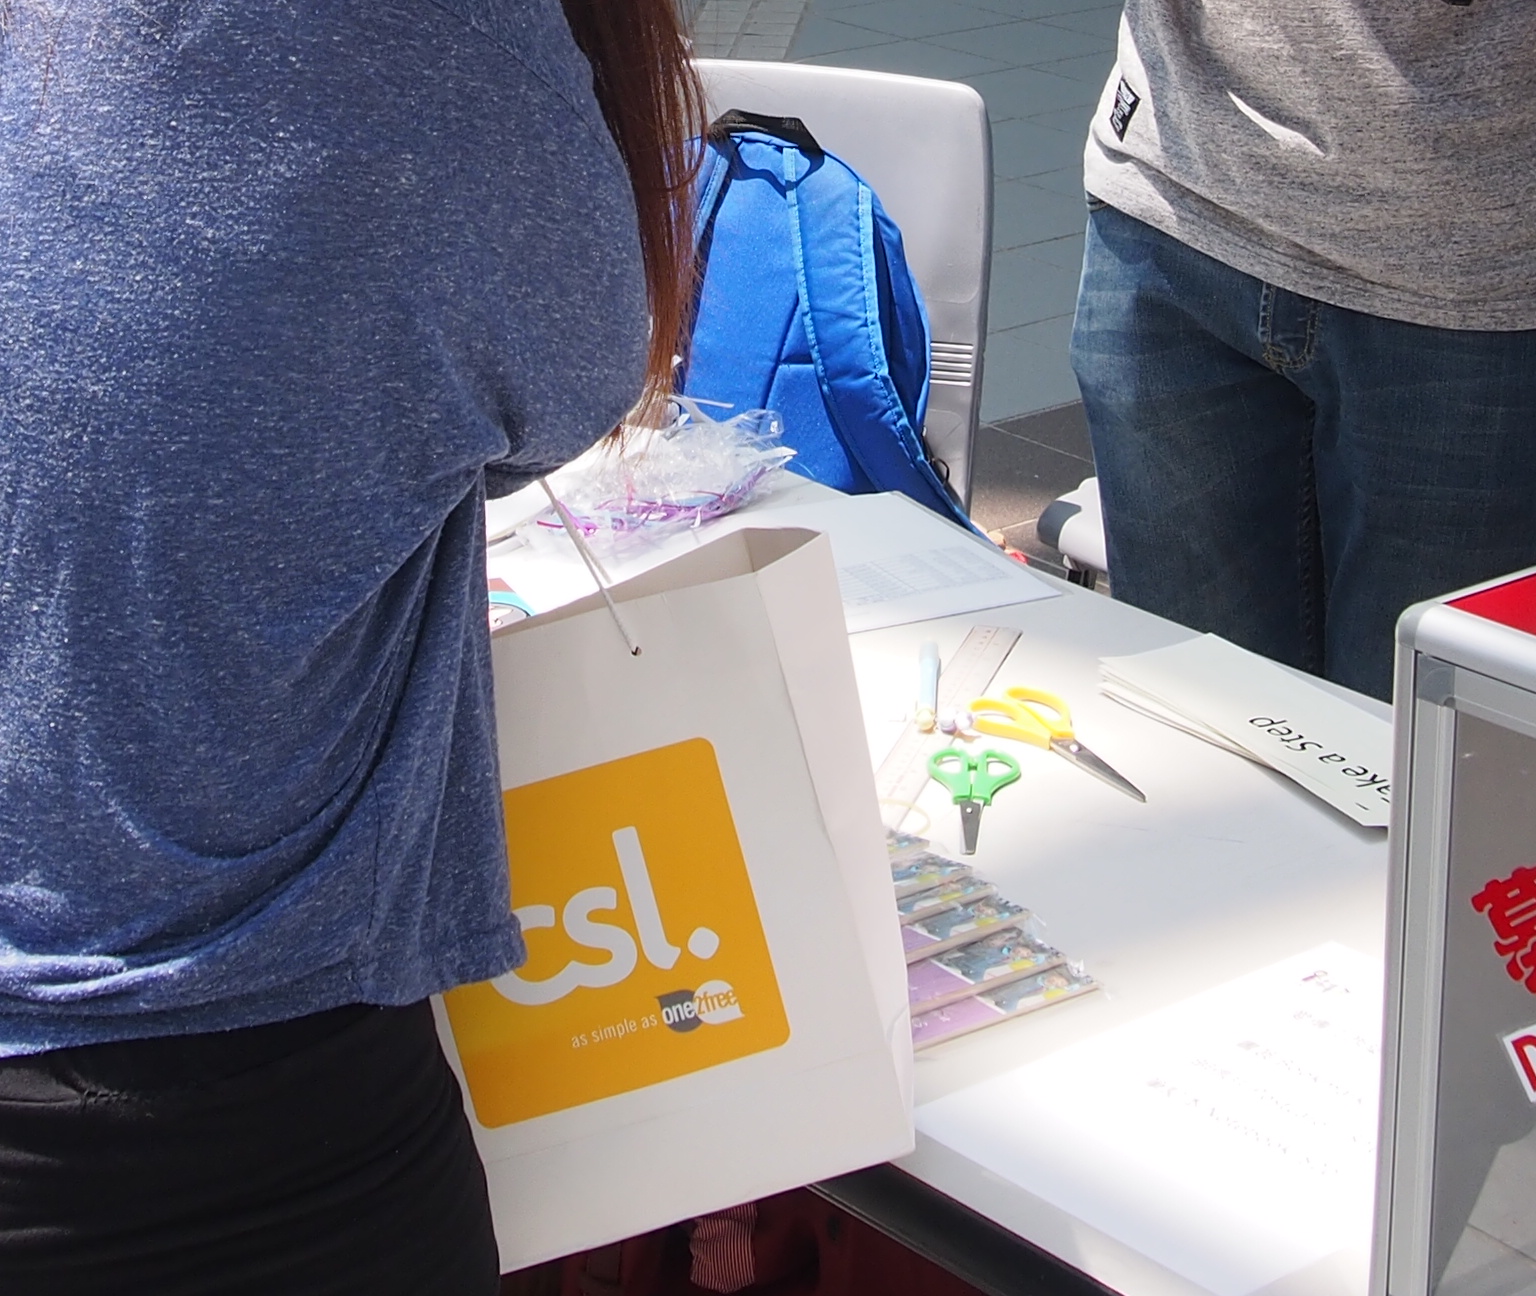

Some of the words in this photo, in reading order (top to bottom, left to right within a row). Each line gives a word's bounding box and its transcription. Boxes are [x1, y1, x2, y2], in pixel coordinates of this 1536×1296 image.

[1249, 716, 1324, 752] Step
[1318, 752, 1346, 764] a
[1341, 765, 1391, 803] ake
[571, 1034, 588, 1049] as
[591, 1019, 637, 1043] simple
[641, 1014, 658, 1029] as
[661, 989, 738, 1025] one2free
